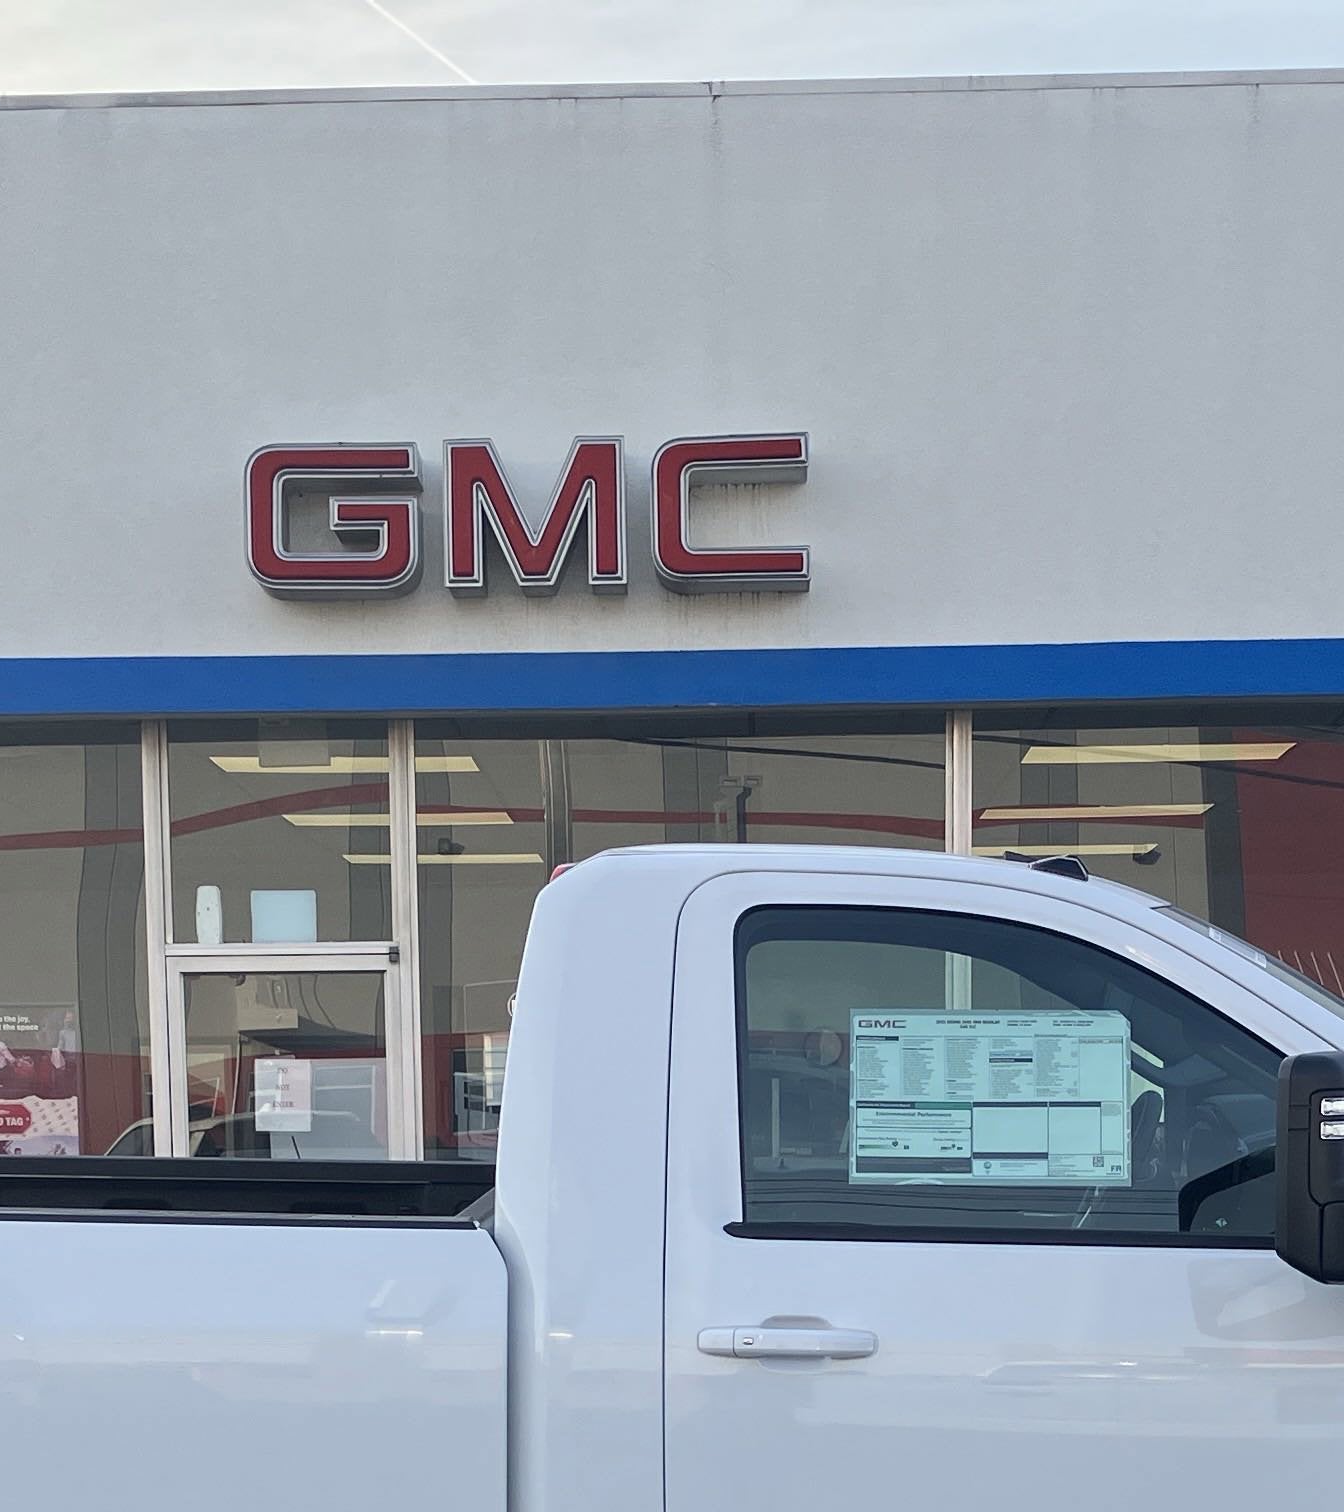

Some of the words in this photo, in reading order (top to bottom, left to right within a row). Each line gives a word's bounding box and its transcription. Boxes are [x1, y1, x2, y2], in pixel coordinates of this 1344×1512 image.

[246, 432, 810, 601] GMC
[3, 1015, 16, 1023] the
[858, 1019, 907, 1029] GMC
[16, 1024, 39, 1032] space
[5, 1116, 24, 1127] TAG
